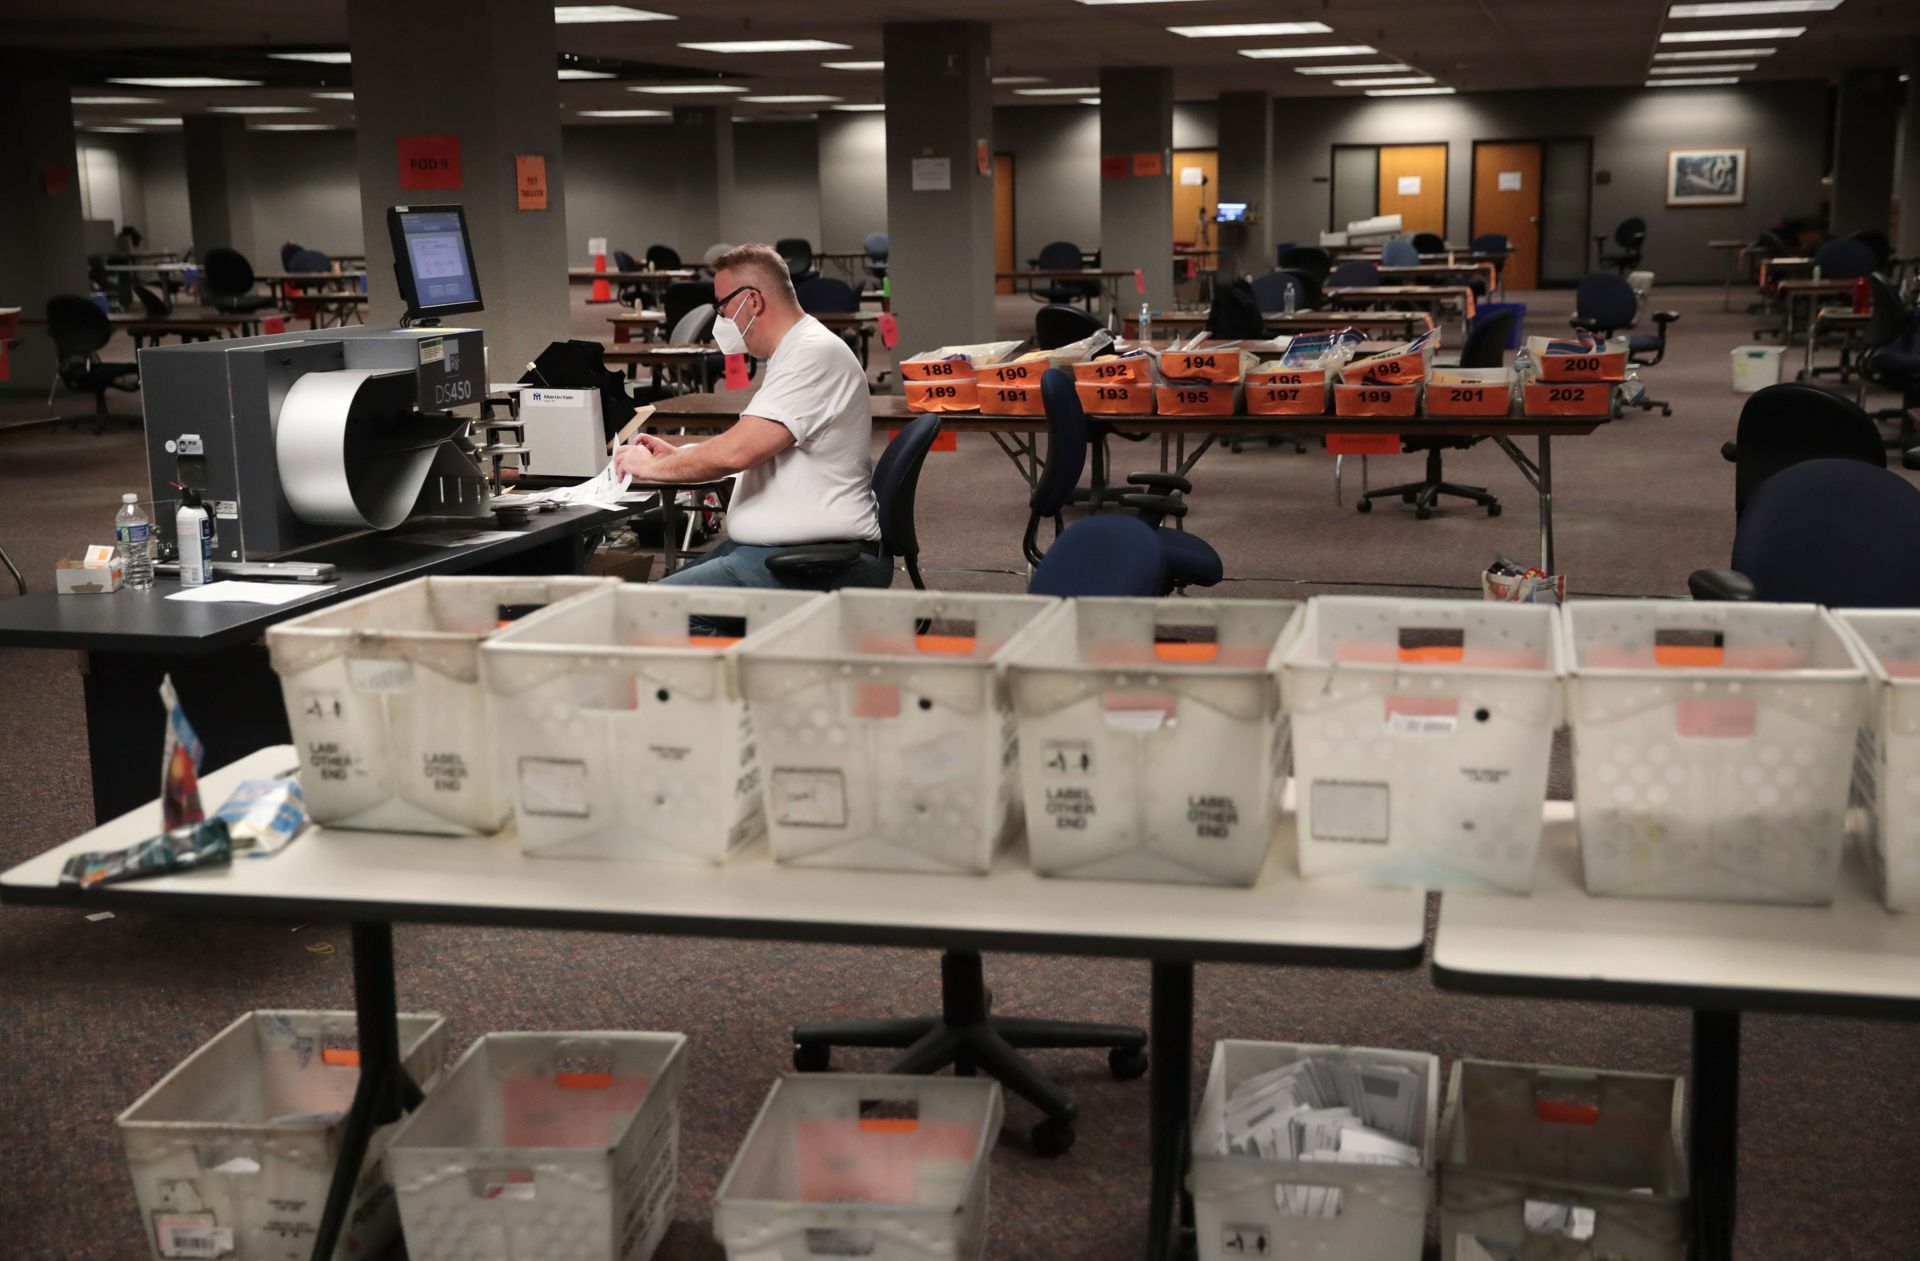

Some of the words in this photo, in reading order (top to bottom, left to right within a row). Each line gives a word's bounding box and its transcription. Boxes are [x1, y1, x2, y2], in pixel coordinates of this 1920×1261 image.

[410, 158, 437, 171] POD
[440, 158, 449, 170] 9
[1183, 356, 1216, 369] 194
[1564, 358, 1601, 372] 200
[921, 363, 954, 377] 188
[996, 366, 1028, 382] 190
[1095, 364, 1127, 378] 192
[1367, 362, 1401, 379] 198
[1268, 374, 1301, 385] 196
[435, 379, 472, 404] DS450
[924, 386, 957, 400] 189
[997, 389, 1028, 403] 191
[1096, 387, 1129, 401] 193
[1176, 390, 1209, 405] 195
[1267, 389, 1300, 402] 197
[1357, 390, 1392, 404] 199
[1450, 389, 1484, 403] 201
[1549, 388, 1585, 402] 202
[310, 756, 351, 769] OTHER
[423, 752, 464, 766] LABEL
[321, 767, 347, 781] END
[424, 765, 468, 779] OTHER
[434, 779, 461, 793] END
[1046, 787, 1092, 801] LABEL
[1046, 801, 1095, 816] OTHER
[1188, 795, 1236, 810] LABEL
[1056, 817, 1087, 829] END
[1187, 809, 1238, 825] OTHER
[1197, 824, 1229, 839] END
